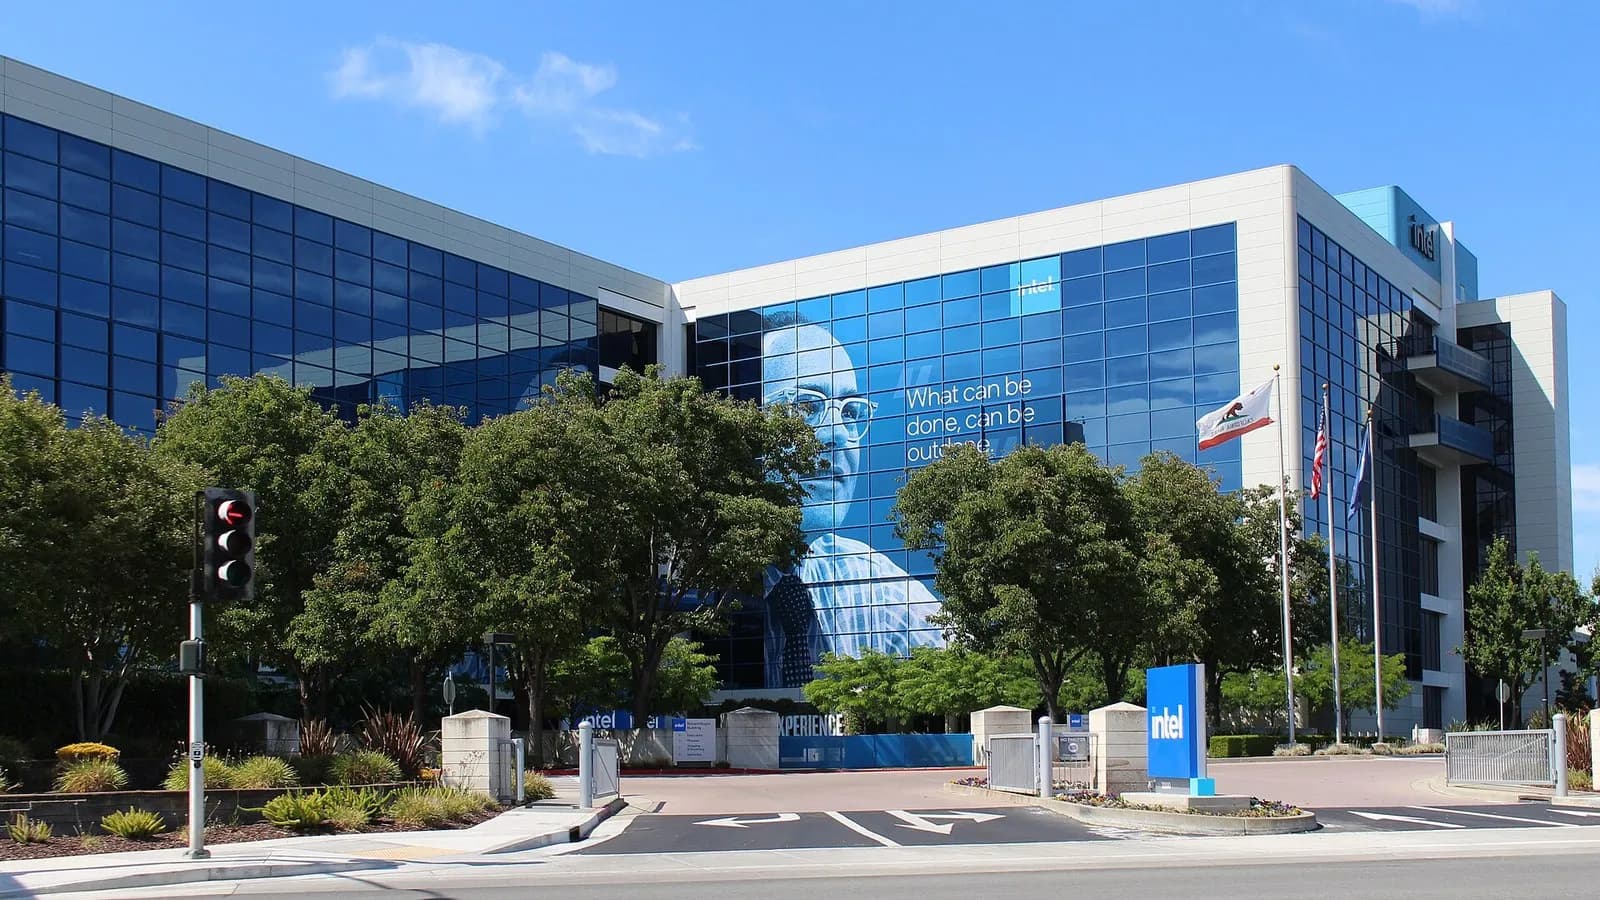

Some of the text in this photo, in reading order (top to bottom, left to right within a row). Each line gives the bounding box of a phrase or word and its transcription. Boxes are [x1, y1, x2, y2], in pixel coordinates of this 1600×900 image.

[1408, 214, 1434, 261] intel
[907, 376, 1032, 409] What can be
[907, 404, 1035, 436] done, can be
[777, 714, 844, 737] XPERIENCE
[1152, 704, 1184, 739] intel
